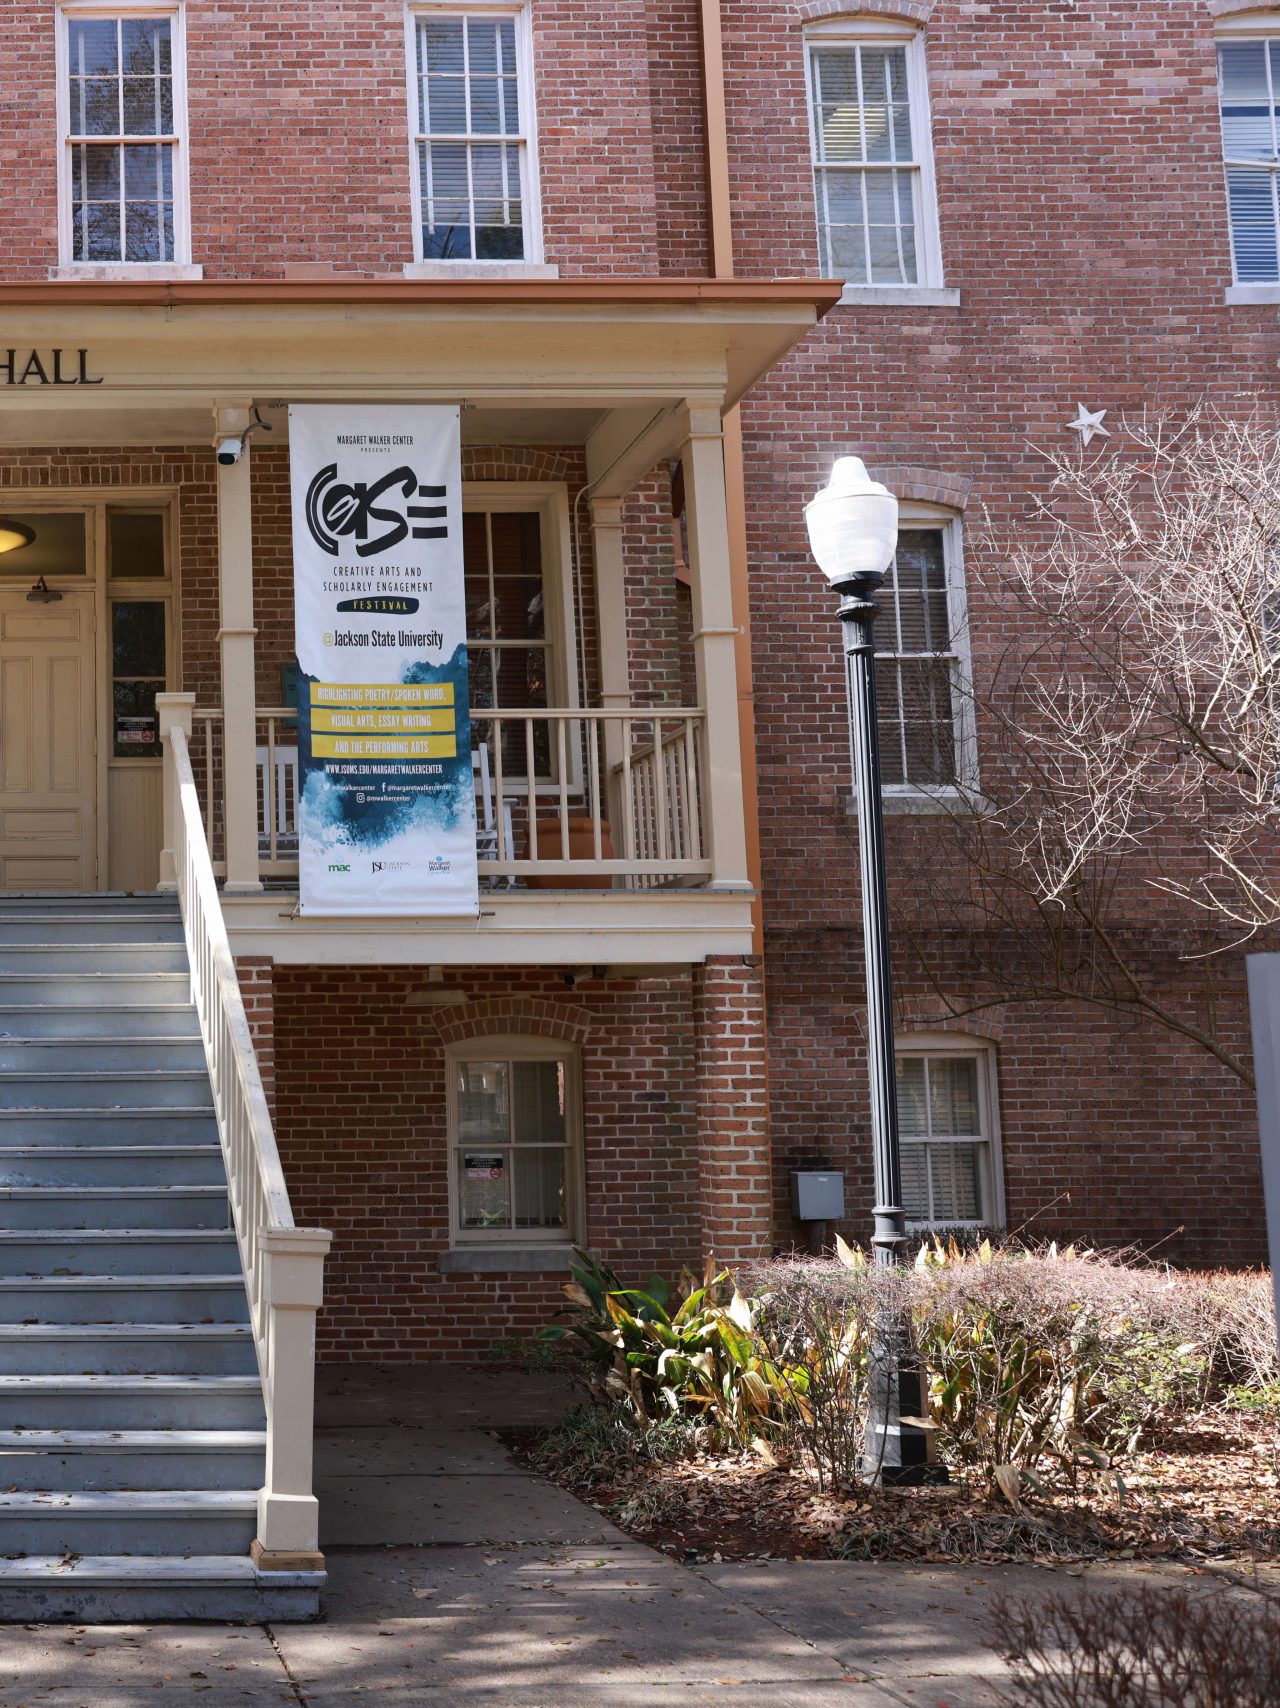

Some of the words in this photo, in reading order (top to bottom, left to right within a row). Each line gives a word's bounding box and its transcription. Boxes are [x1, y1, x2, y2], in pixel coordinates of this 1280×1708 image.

[336, 435, 367, 445] MARGARET
[369, 435, 391, 445] WALKER
[392, 435, 414, 445] CENTER
[333, 566, 375, 577] CREATIVE
[379, 566, 401, 577] ARTS
[404, 566, 422, 577] AND
[323, 581, 372, 592] SCHOLARLY
[376, 582, 433, 592] ENGAGEMENT
[353, 600, 409, 610] FESTIVAL
[323, 630, 370, 647] @Jackson
[371, 630, 396, 647] State
[398, 631, 443, 650] University
[317, 687, 363, 700] HIGHLIGHTING
[365, 688, 421, 702] POETRY/SPOKEN
[423, 688, 447, 702] WORD,
[330, 714, 355, 727] VISUAL
[356, 715, 377, 728] ARTS,
[378, 715, 400, 727] ESSAY
[402, 714, 432, 727] WRITING
[335, 741, 349, 753] AND
[351, 741, 364, 753] THE
[365, 741, 409, 753] PERFORMING
[411, 741, 429, 753] ARTS
[325, 764, 443, 775] WWW.JSUMS.EDU/MARGARETWALKERCENTER
[328, 864, 351, 872] mac
